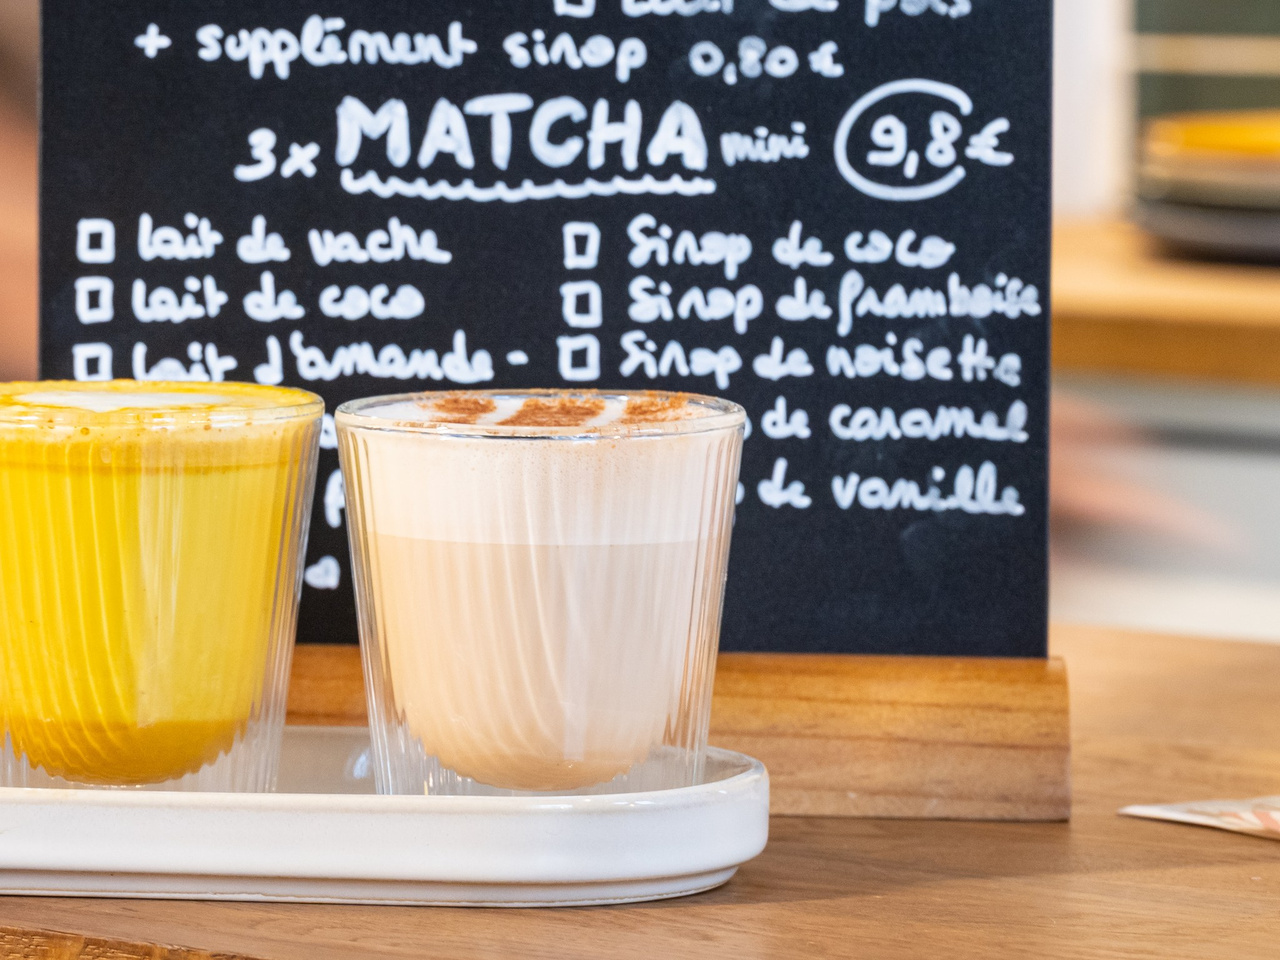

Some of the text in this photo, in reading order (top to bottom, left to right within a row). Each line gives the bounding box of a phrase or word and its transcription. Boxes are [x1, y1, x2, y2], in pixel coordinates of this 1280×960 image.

[503, 29, 646, 82] sirop
[234, 93, 809, 181] 3x MATCHA mini
[237, 215, 291, 263] de
[308, 217, 452, 266] vache
[627, 214, 955, 280] Sirop de coco
[243, 271, 305, 322] de
[319, 284, 425, 320] coco
[628, 270, 1041, 336] Sirop de framboise
[254, 330, 494, 387] d'amande
[620, 330, 1021, 389] Sirop de noisette
[762, 396, 811, 438] de
[829, 401, 1028, 442] caramel
[758, 458, 811, 508] de
[832, 462, 1025, 515] vanille
